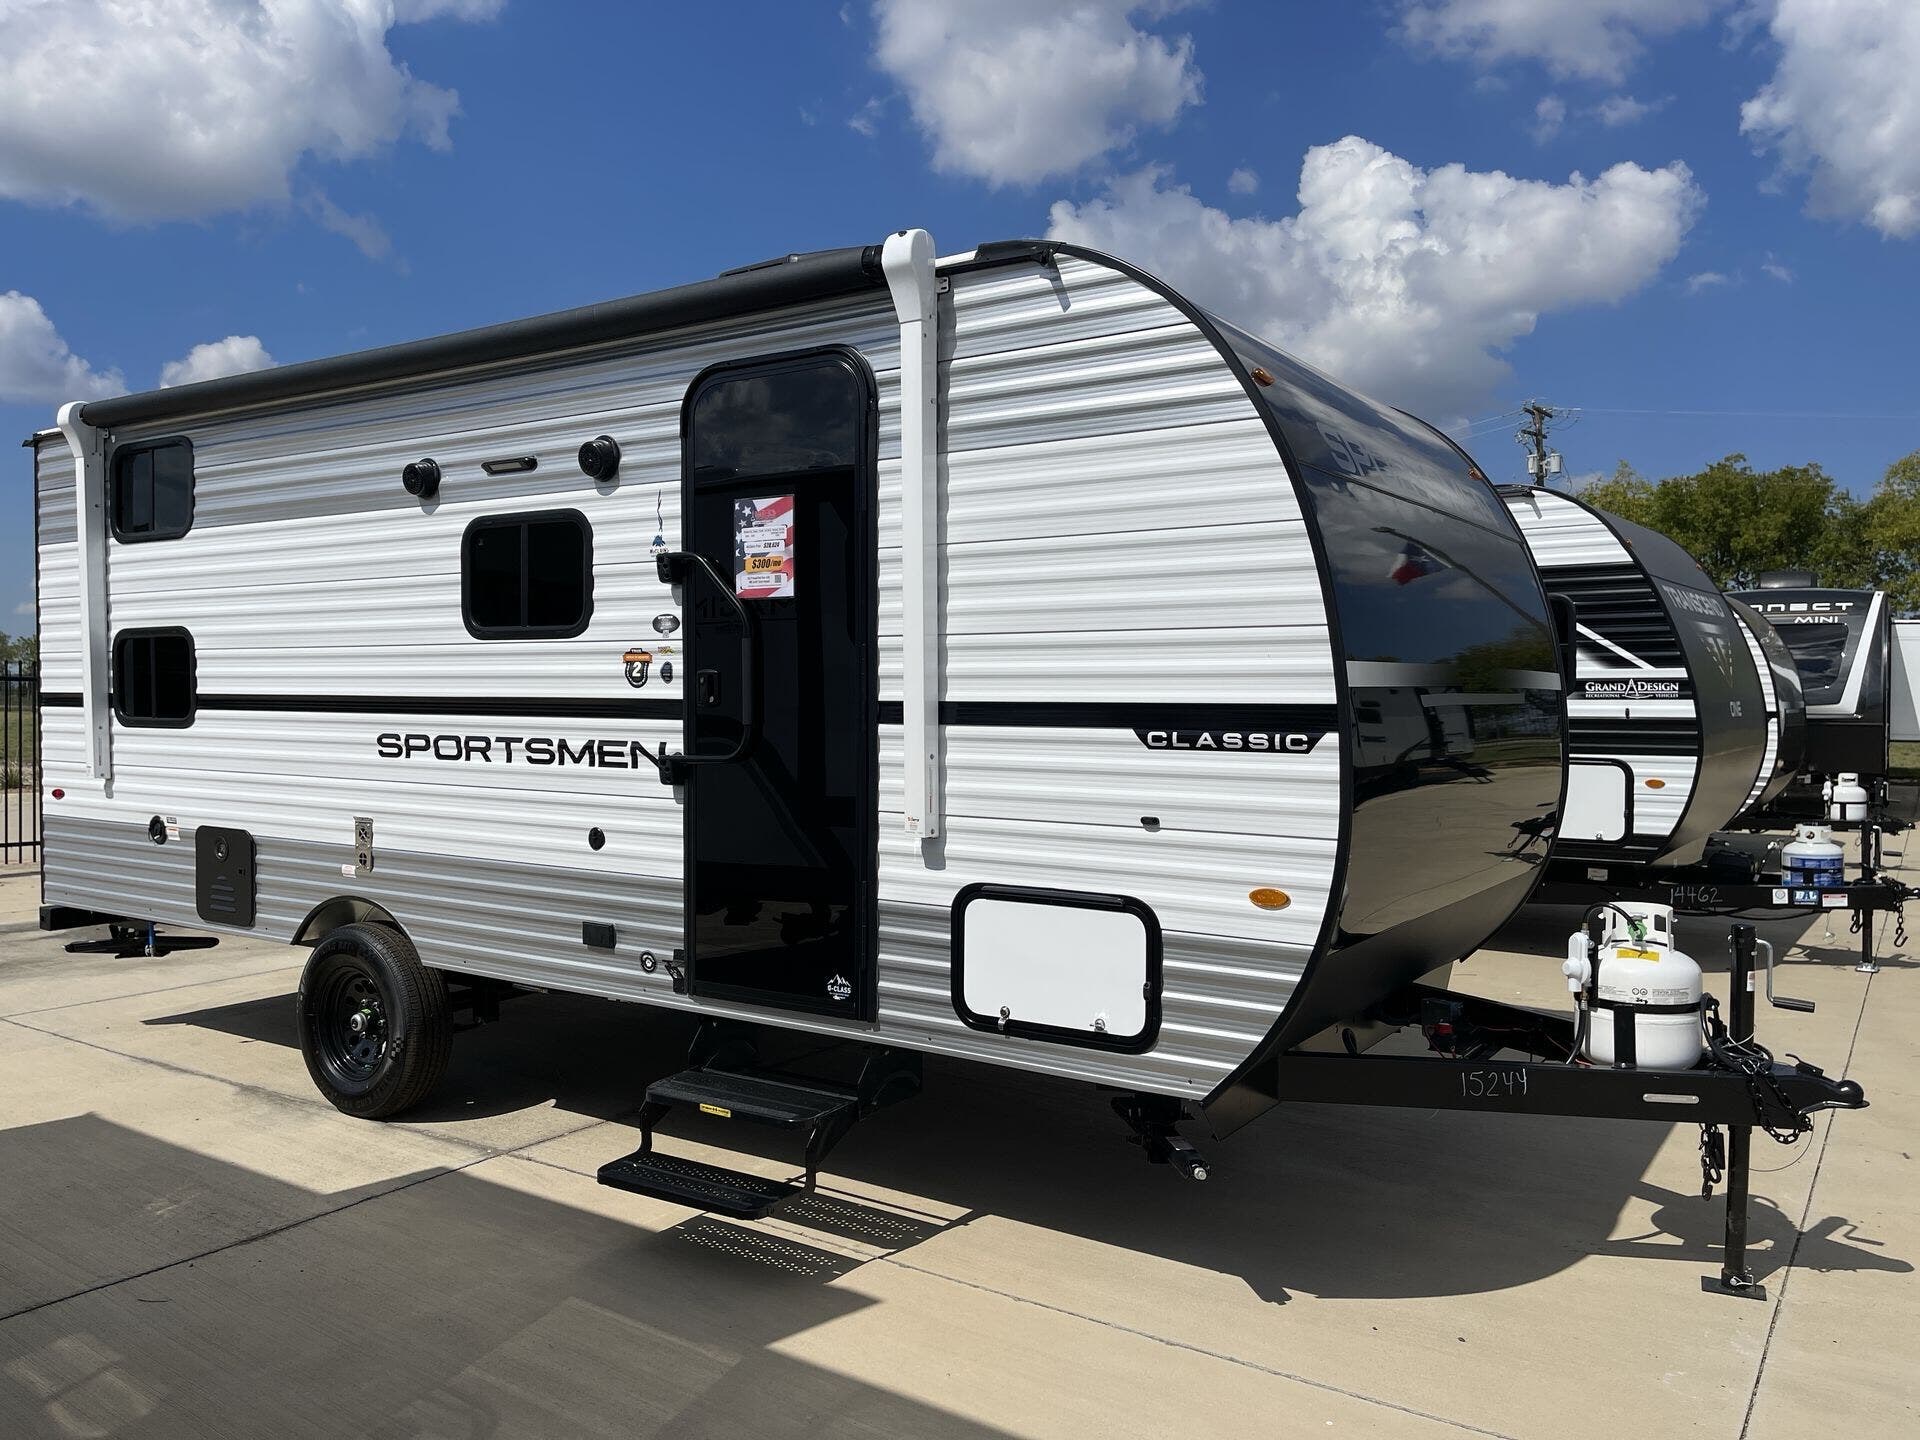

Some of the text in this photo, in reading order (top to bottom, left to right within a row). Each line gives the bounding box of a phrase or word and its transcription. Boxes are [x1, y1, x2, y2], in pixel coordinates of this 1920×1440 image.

[751, 558, 782, 570] $300/mo
[1661, 584, 1725, 618] TRANSCEND
[1749, 602, 1854, 612] NNECT
[1794, 615, 1839, 624] MINI
[632, 661, 642, 677] 2
[1585, 681, 1679, 691] GRAND DESIGN
[1729, 700, 1742, 717] ONE
[1147, 731, 1308, 750] CLASSIC
[376, 733, 667, 769] SPORTSMEN
[1670, 886, 1723, 904] 14462
[827, 984, 851, 994] G-CLASS
[1462, 1068, 1527, 1097] 15244
